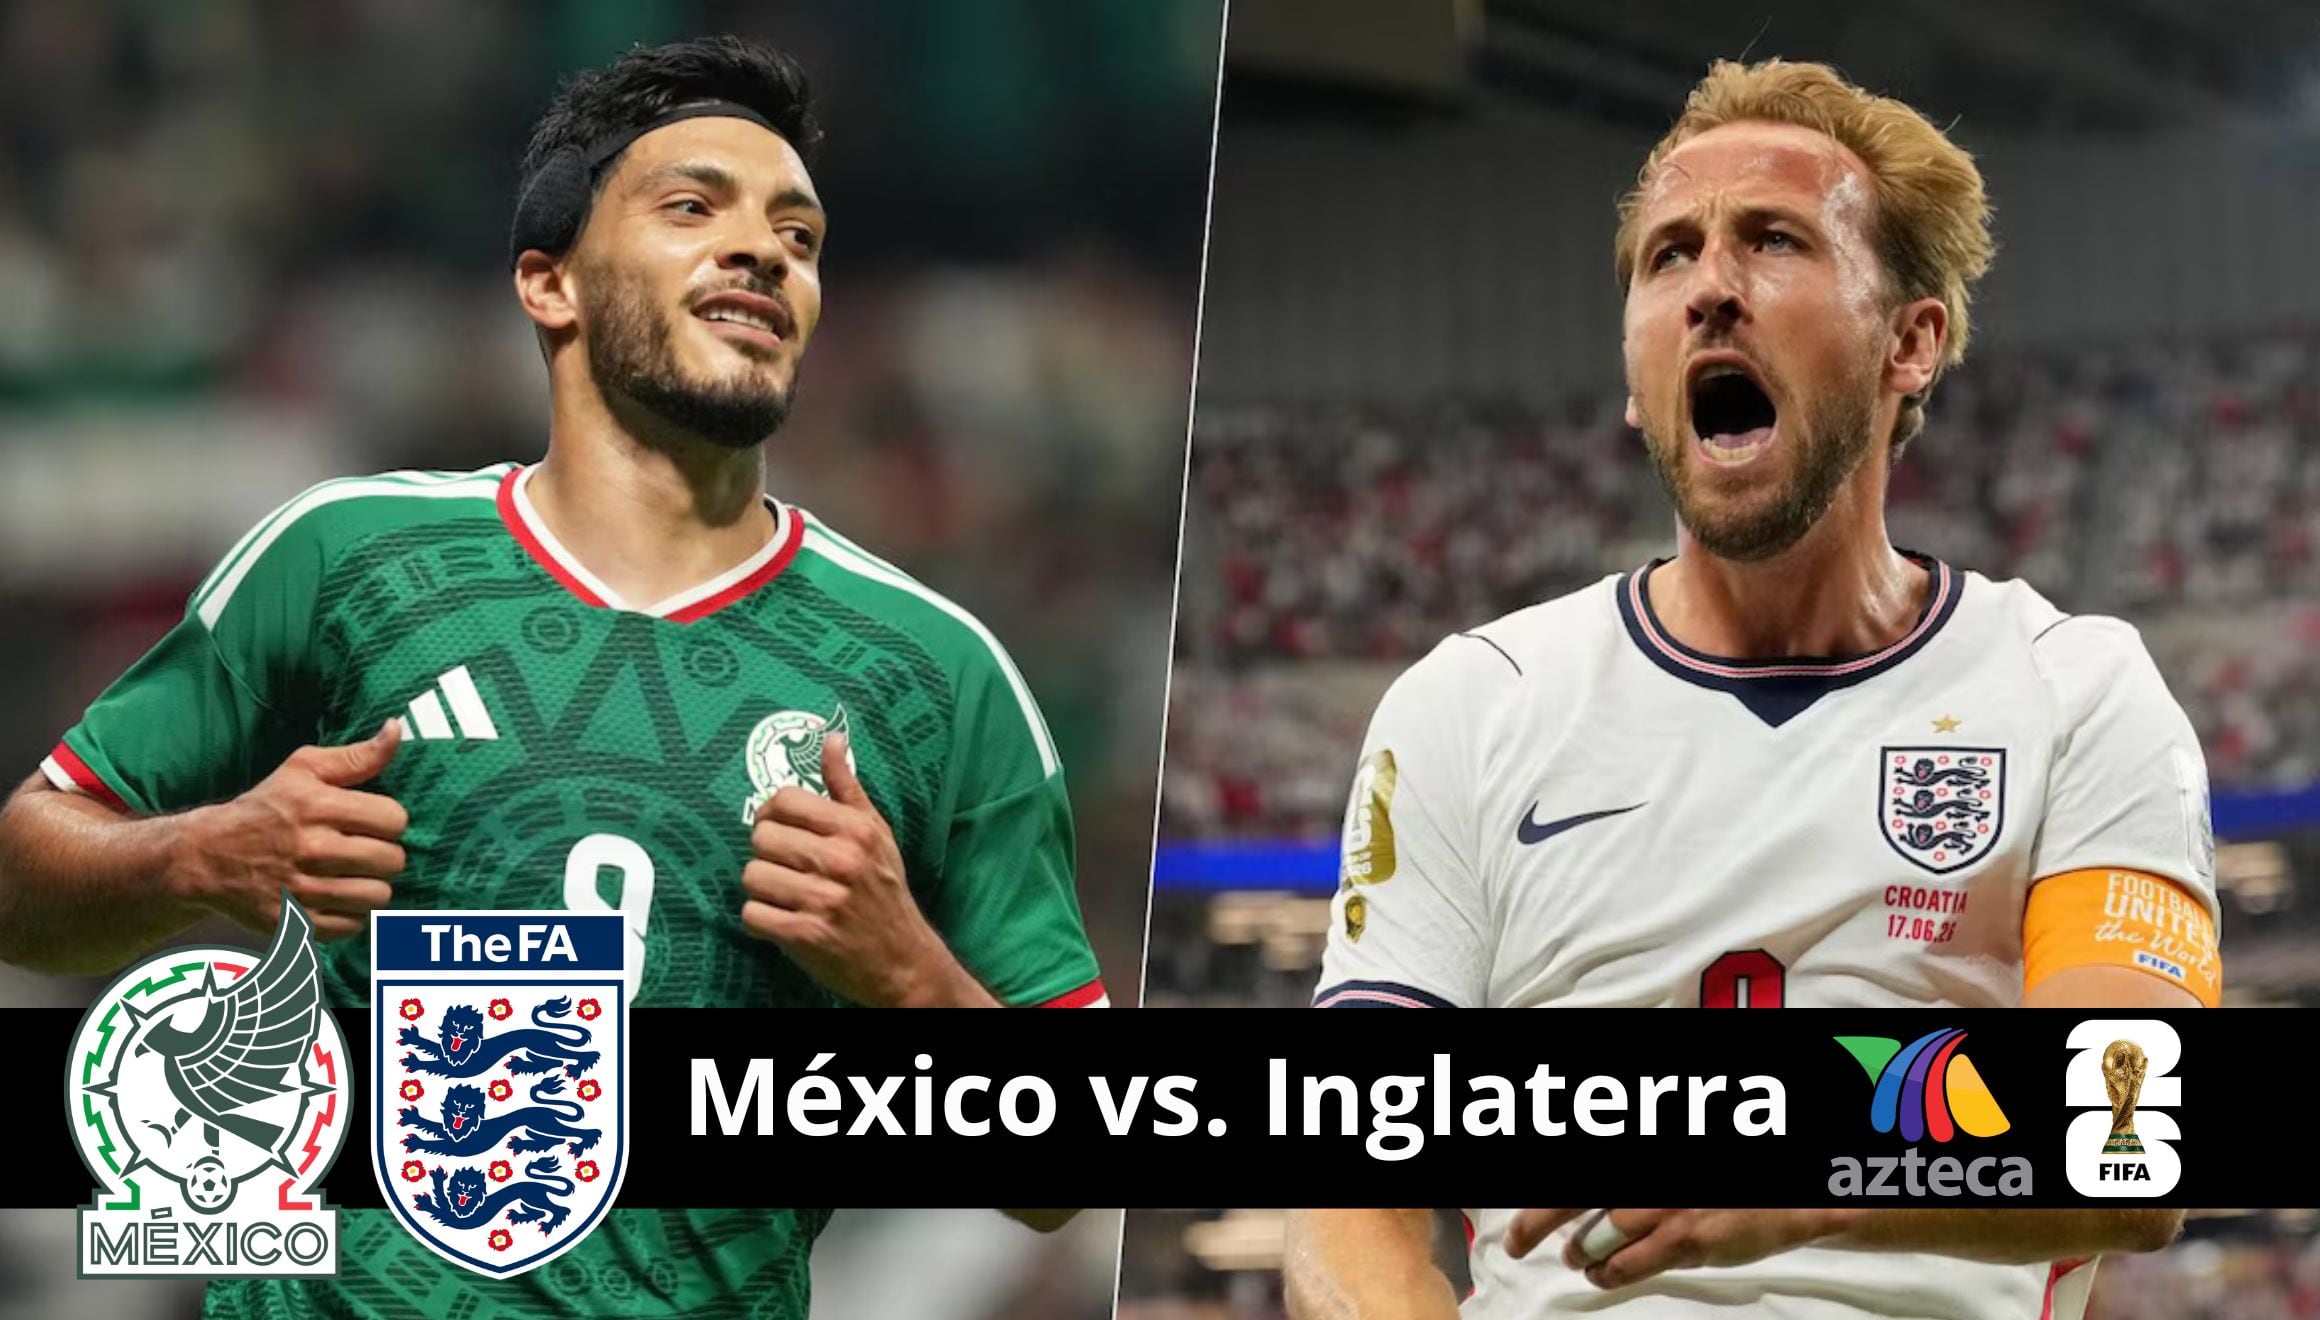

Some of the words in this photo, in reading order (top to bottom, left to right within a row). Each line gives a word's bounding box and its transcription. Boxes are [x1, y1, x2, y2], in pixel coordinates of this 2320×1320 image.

[1884, 885, 1968, 914] CROATIA
[2095, 917, 2144, 943] the
[2138, 953, 2182, 979] FIFA
